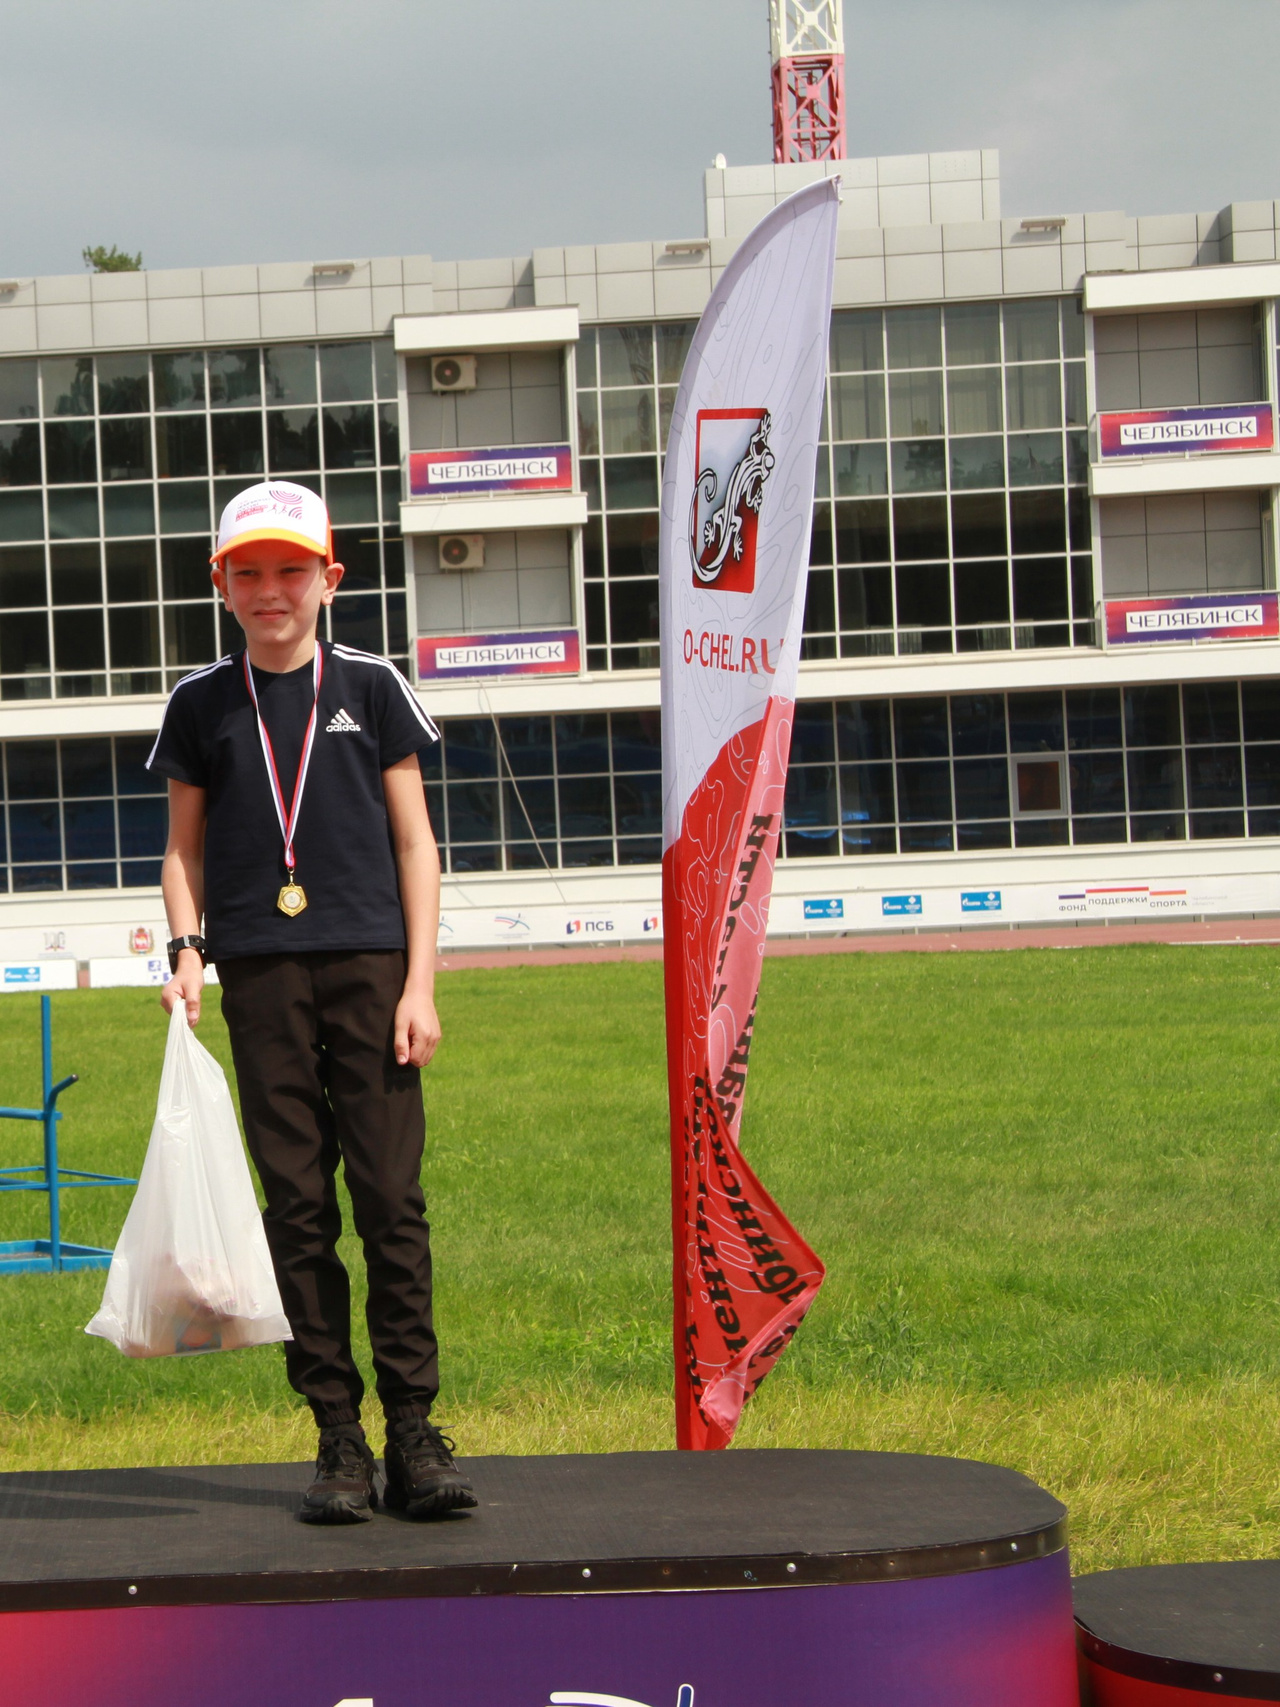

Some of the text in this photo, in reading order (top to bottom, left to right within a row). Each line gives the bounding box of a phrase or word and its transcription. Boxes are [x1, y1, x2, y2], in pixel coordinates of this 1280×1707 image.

[1124, 420, 1253, 440] ЧЕЛЯБИНСК
[431, 461, 553, 479] ЧЕЛЯБИНСК
[1129, 608, 1259, 628] ЧЕЛЯБИНСК
[439, 645, 561, 663] ЧЕЛЯБИНСК
[683, 628, 784, 675] O-CHEL.RU
[326, 721, 361, 732] adidas
[1058, 904, 1087, 912] ФОНД
[1088, 896, 1148, 906] ПОДДЕРЖКИ
[1149, 900, 1187, 908] СПОРТА
[585, 920, 614, 932] ПСБ
